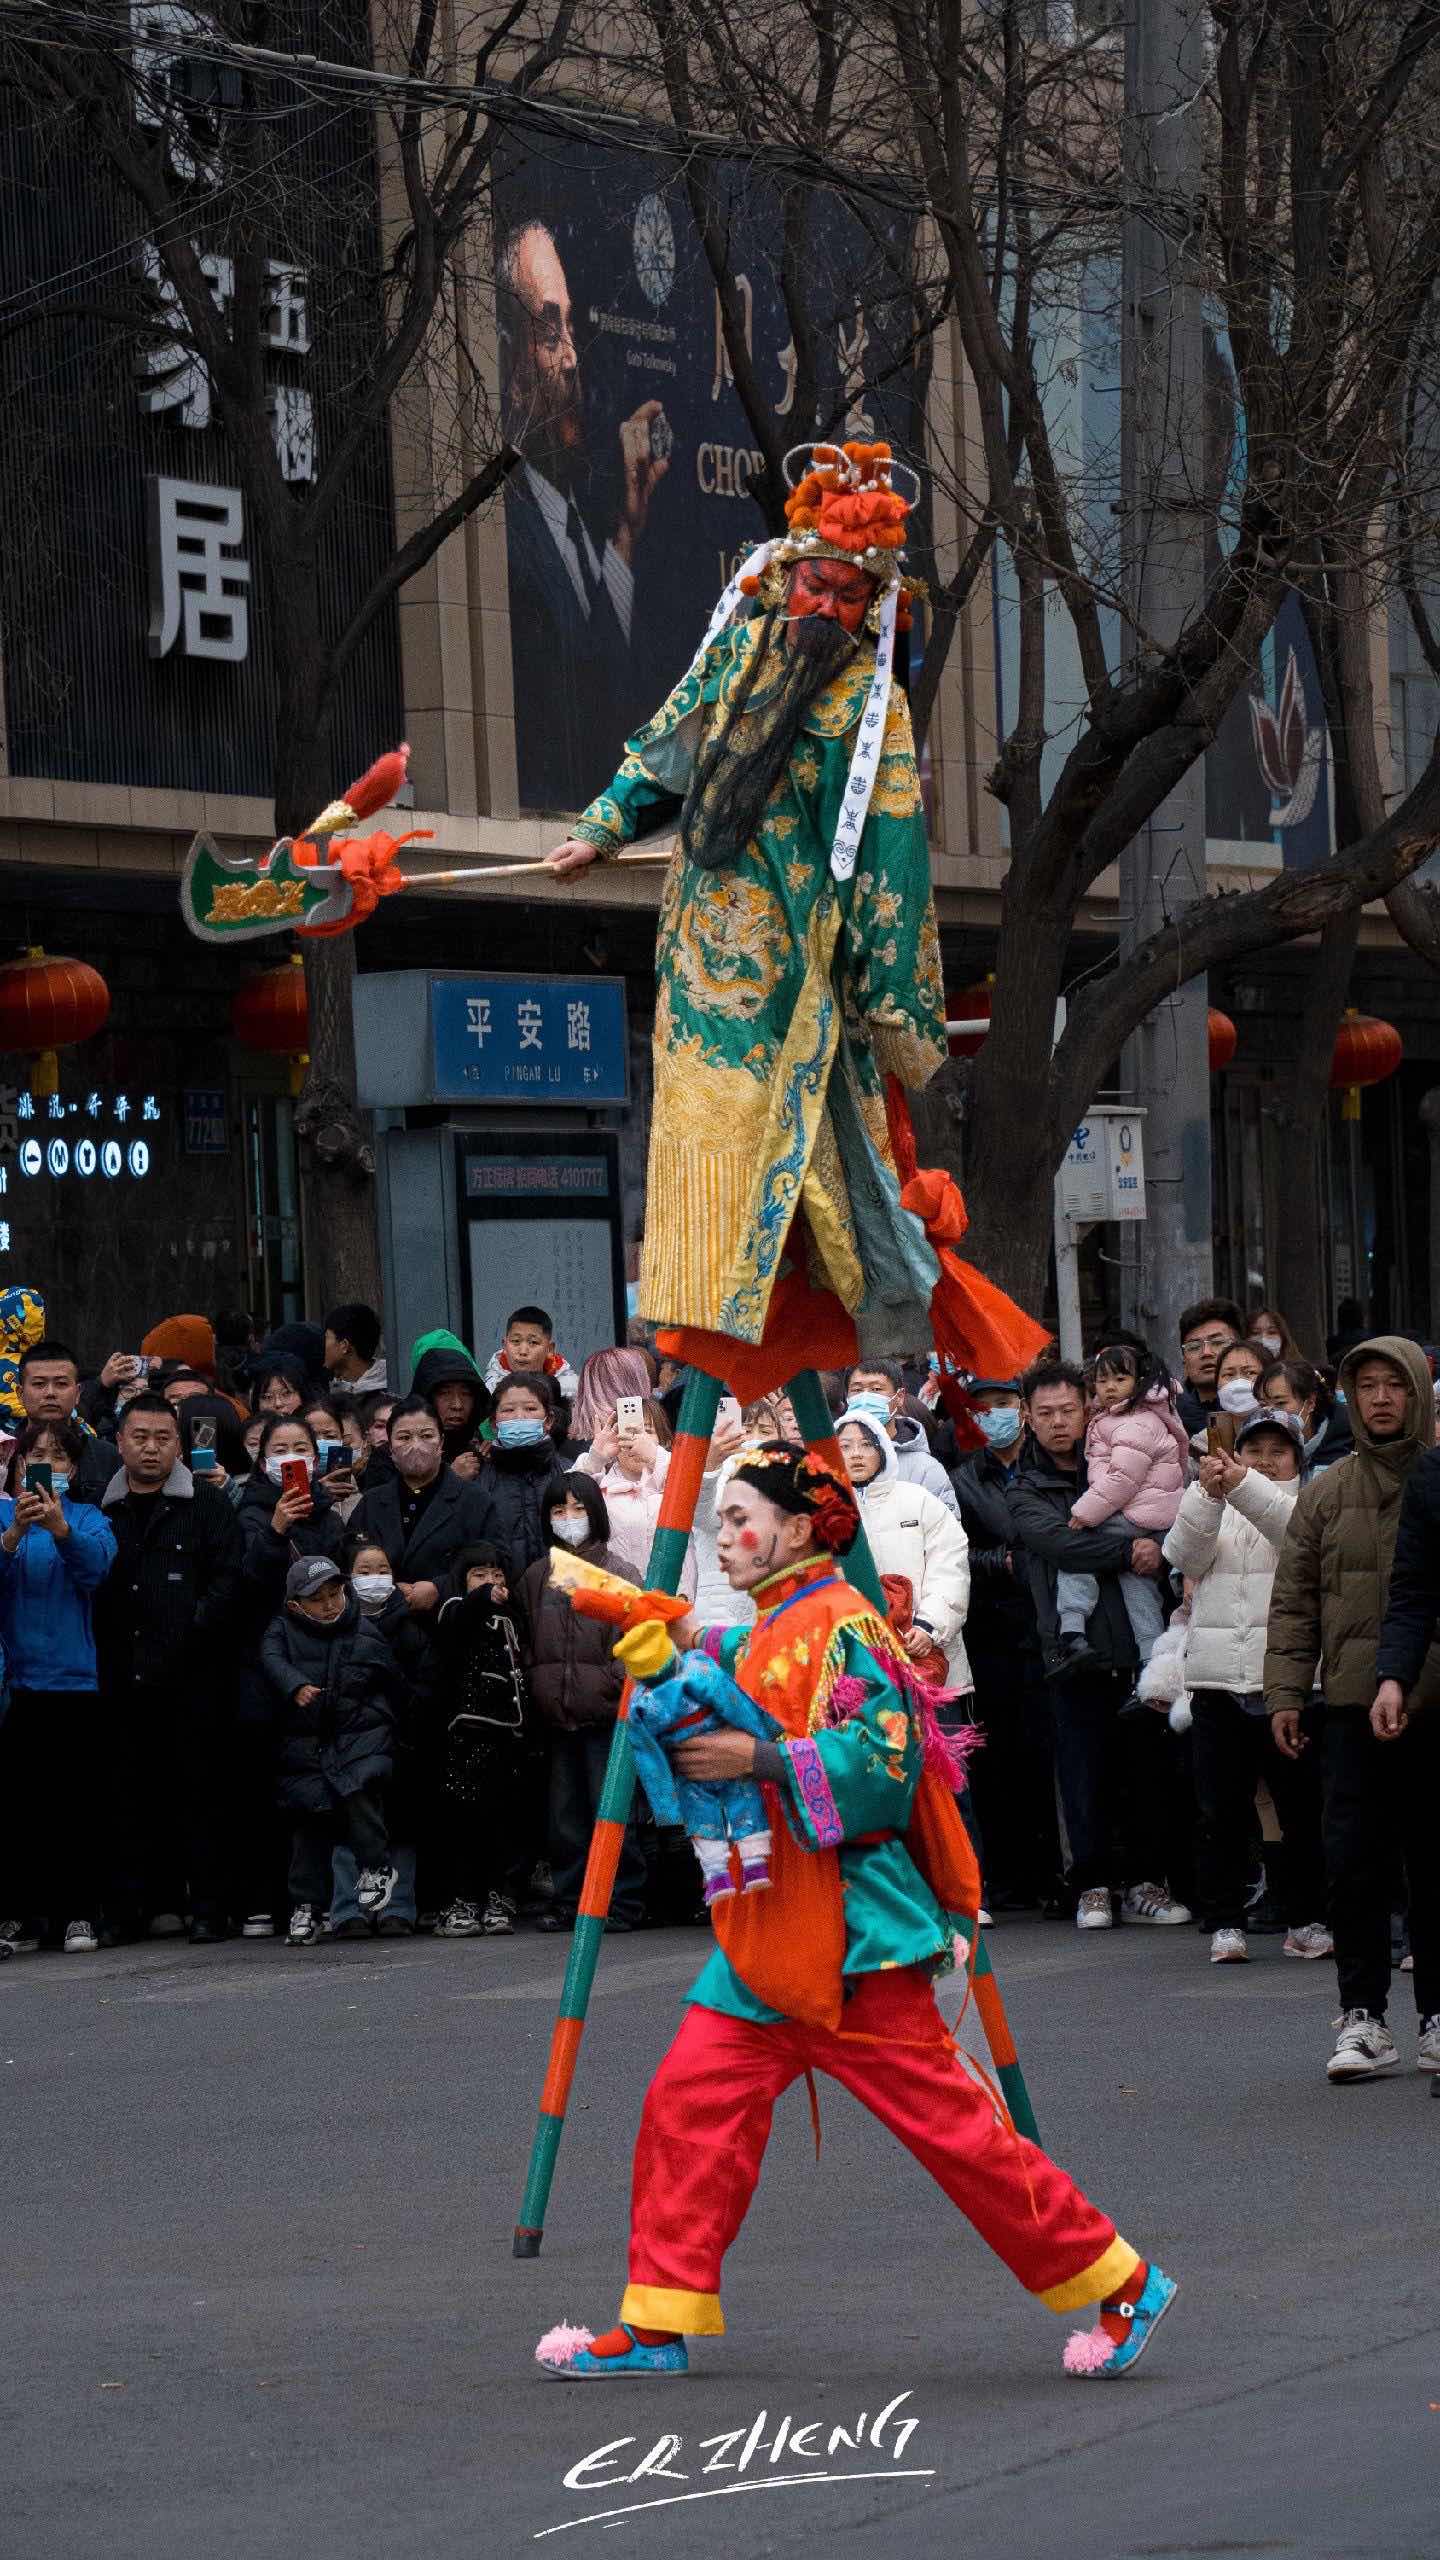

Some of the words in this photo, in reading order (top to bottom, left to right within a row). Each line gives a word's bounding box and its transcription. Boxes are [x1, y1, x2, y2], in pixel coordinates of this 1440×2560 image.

[466, 997, 591, 1051] 平安路
[504, 1064, 541, 1081] PINGAN
[548, 1065, 561, 1082] LU
[560, 1166, 604, 1188] 4101717
